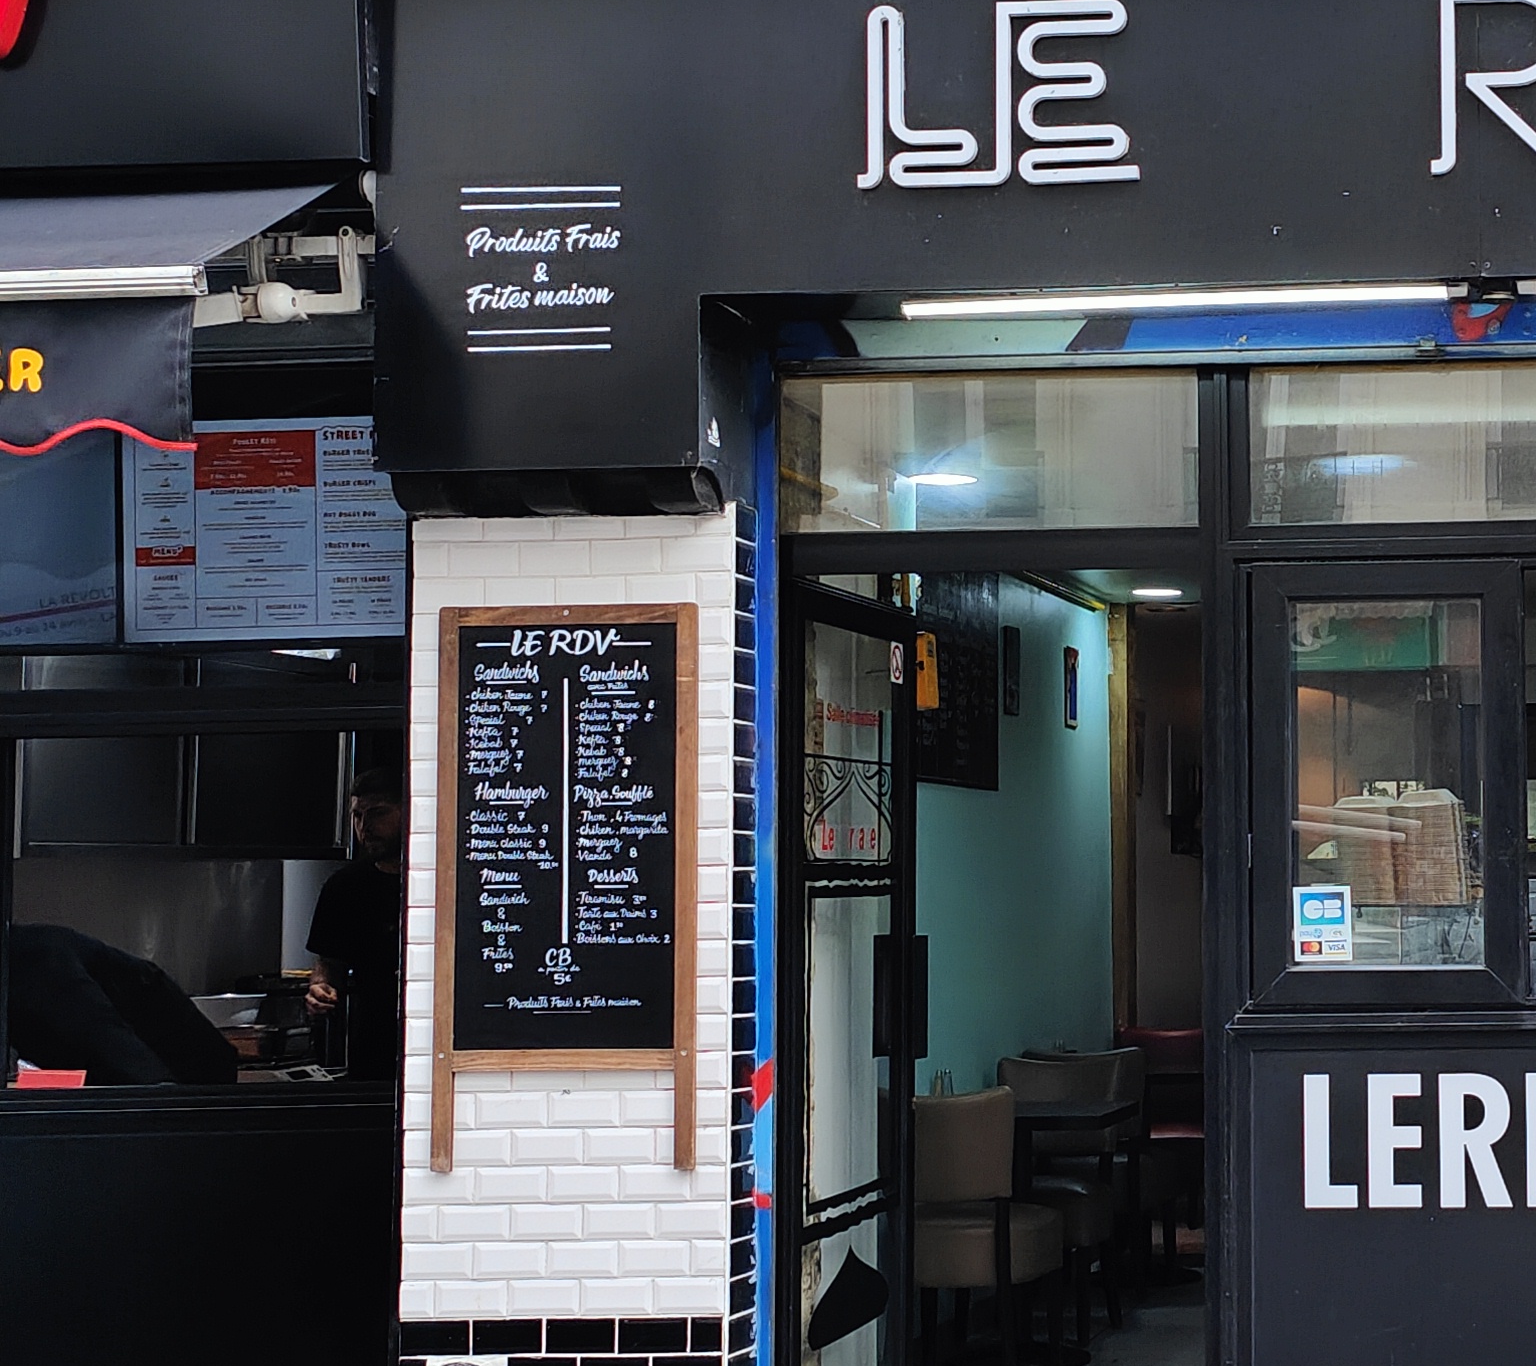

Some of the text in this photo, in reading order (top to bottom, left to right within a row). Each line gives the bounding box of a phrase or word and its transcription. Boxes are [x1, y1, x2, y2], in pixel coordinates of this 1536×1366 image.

[466, 223, 621, 257] Produits Frais
[533, 262, 549, 282] &
[466, 283, 615, 314] Frites maison
[0, 346, 43, 392] R
[549, 628, 621, 655] RDV
[474, 660, 539, 683] Sandwichs
[579, 659, 649, 682] Sandwichs
[577, 745, 607, 757] Kebab
[474, 780, 549, 808] Hamburger
[517, 811, 526, 821] 7
[616, 809, 623, 822] 4
[542, 824, 549, 833] 9
[539, 839, 546, 848] 9
[479, 868, 521, 883] Menu
[587, 867, 639, 883] Desserts
[479, 892, 530, 906] Sandwich
[497, 907, 506, 919] &
[650, 909, 657, 919] 3
[481, 920, 523, 933] Boisson
[497, 934, 506, 946] &
[663, 934, 671, 943] 2
[481, 947, 514, 960] Frites
[545, 947, 572, 966] CB
[506, 995, 549, 1010] Produits
